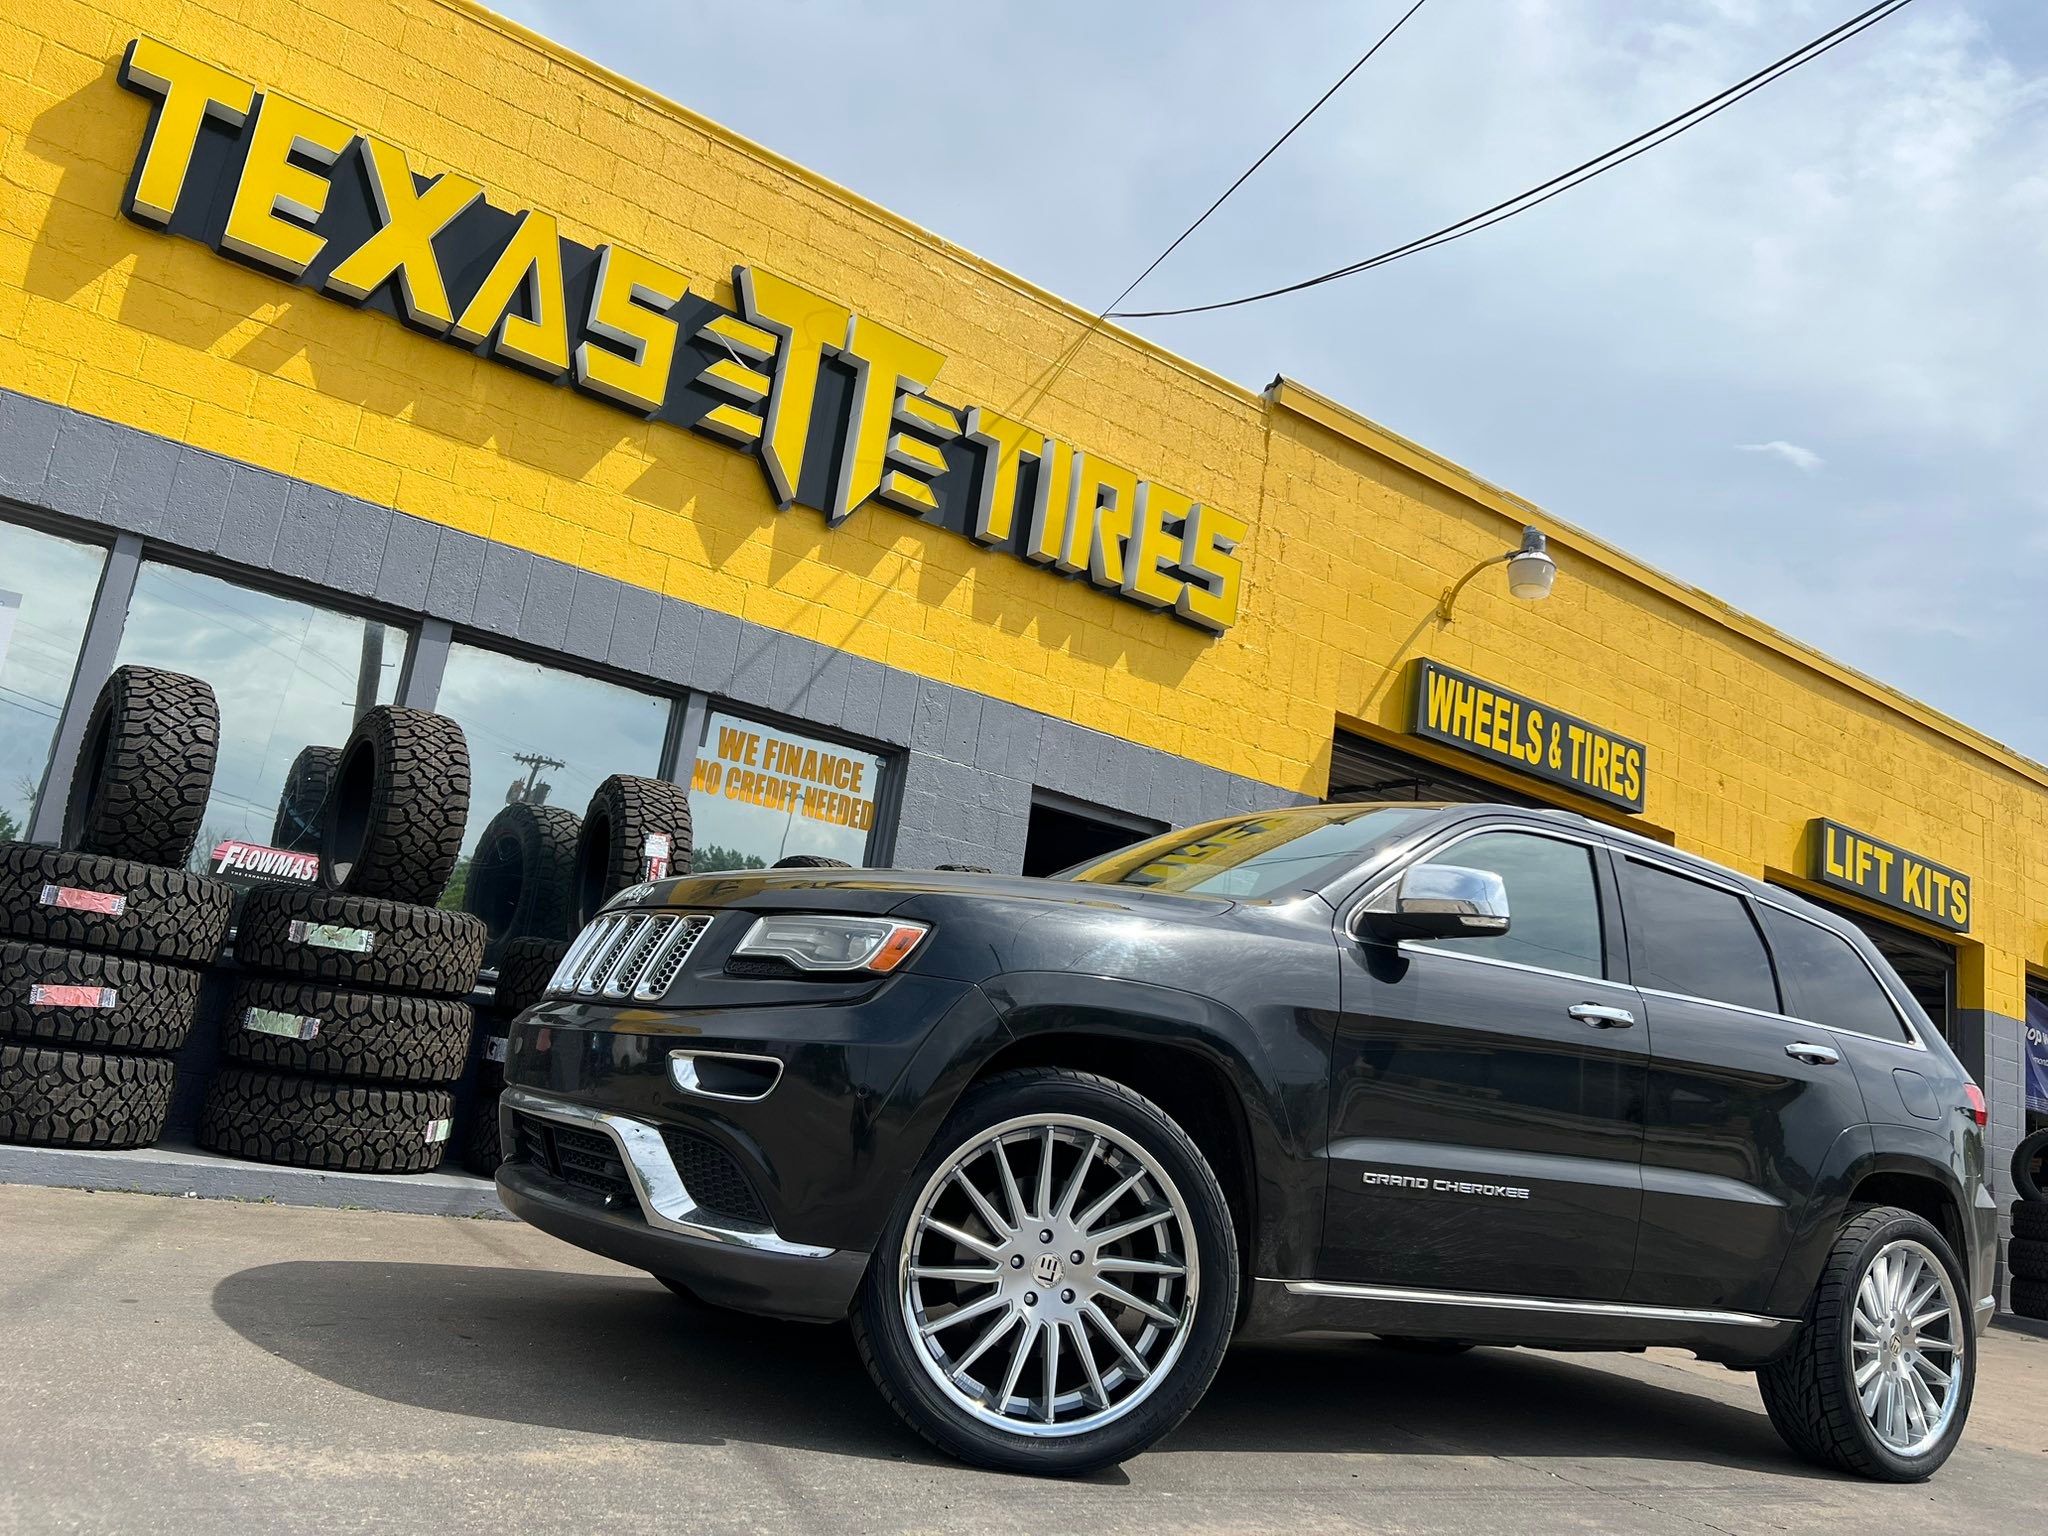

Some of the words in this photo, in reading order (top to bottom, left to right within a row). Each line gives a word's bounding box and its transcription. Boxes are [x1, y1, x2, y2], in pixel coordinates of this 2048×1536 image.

[128, 33, 692, 410] TEXAS
[965, 406, 1251, 632] TIRES
[718, 726, 760, 766] WE
[762, 738, 864, 793] FINANCE
[1427, 671, 1543, 765] WHEELS
[1548, 721, 1562, 770] &
[1568, 724, 1640, 801] TIRES
[690, 757, 723, 795] NO
[724, 766, 801, 814] CREDIT
[801, 785, 875, 832] NEEDED
[1826, 827, 1894, 894] LIFT
[1902, 858, 1968, 924] KITS
[1363, 1172, 1429, 1189] GRAND
[1432, 1179, 1530, 1199] CHEROKEE
